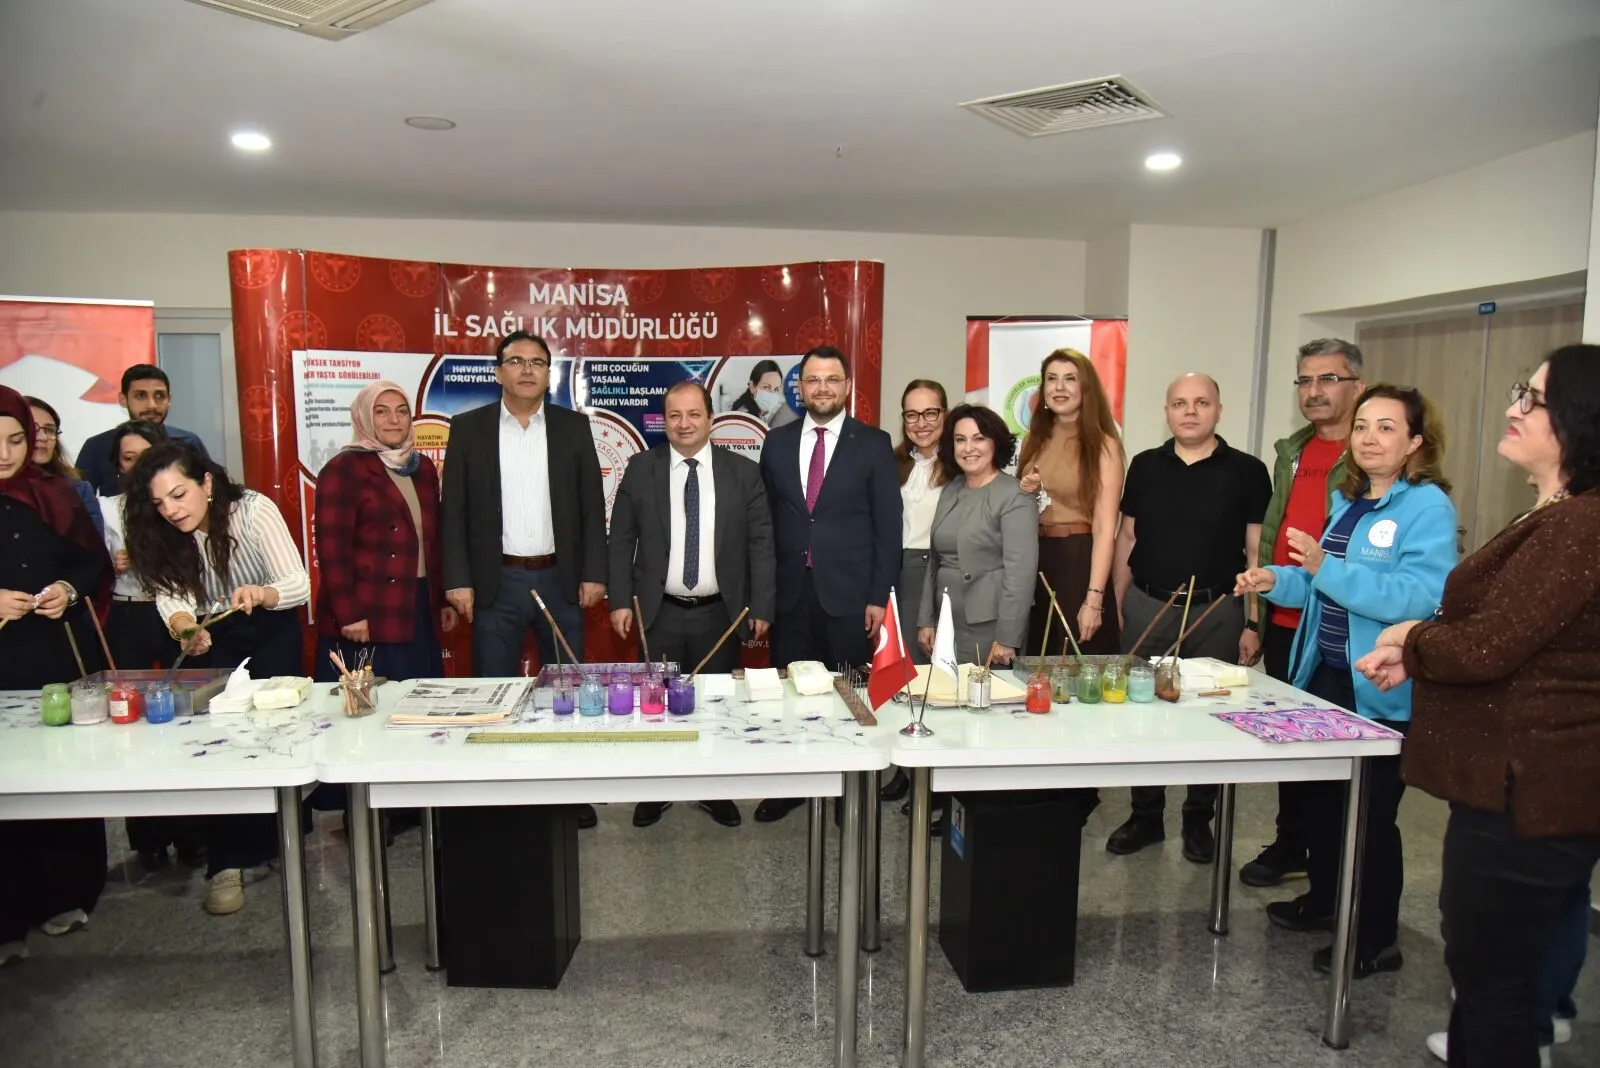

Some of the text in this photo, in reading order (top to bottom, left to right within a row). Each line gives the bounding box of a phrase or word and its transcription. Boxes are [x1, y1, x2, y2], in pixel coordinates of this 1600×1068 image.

[529, 278, 629, 306] MANİSA
[435, 307, 458, 337] İL
[566, 311, 718, 340] MÜDÜRLÜĞÜ
[452, 365, 496, 374] HAVAMIZ
[591, 363, 649, 373] HER ÇOCUĞUN
[591, 376, 626, 385] YAŞAMA
[591, 386, 629, 395] SAĞLIKLI
[591, 398, 649, 407] HAKKI VARDIR
